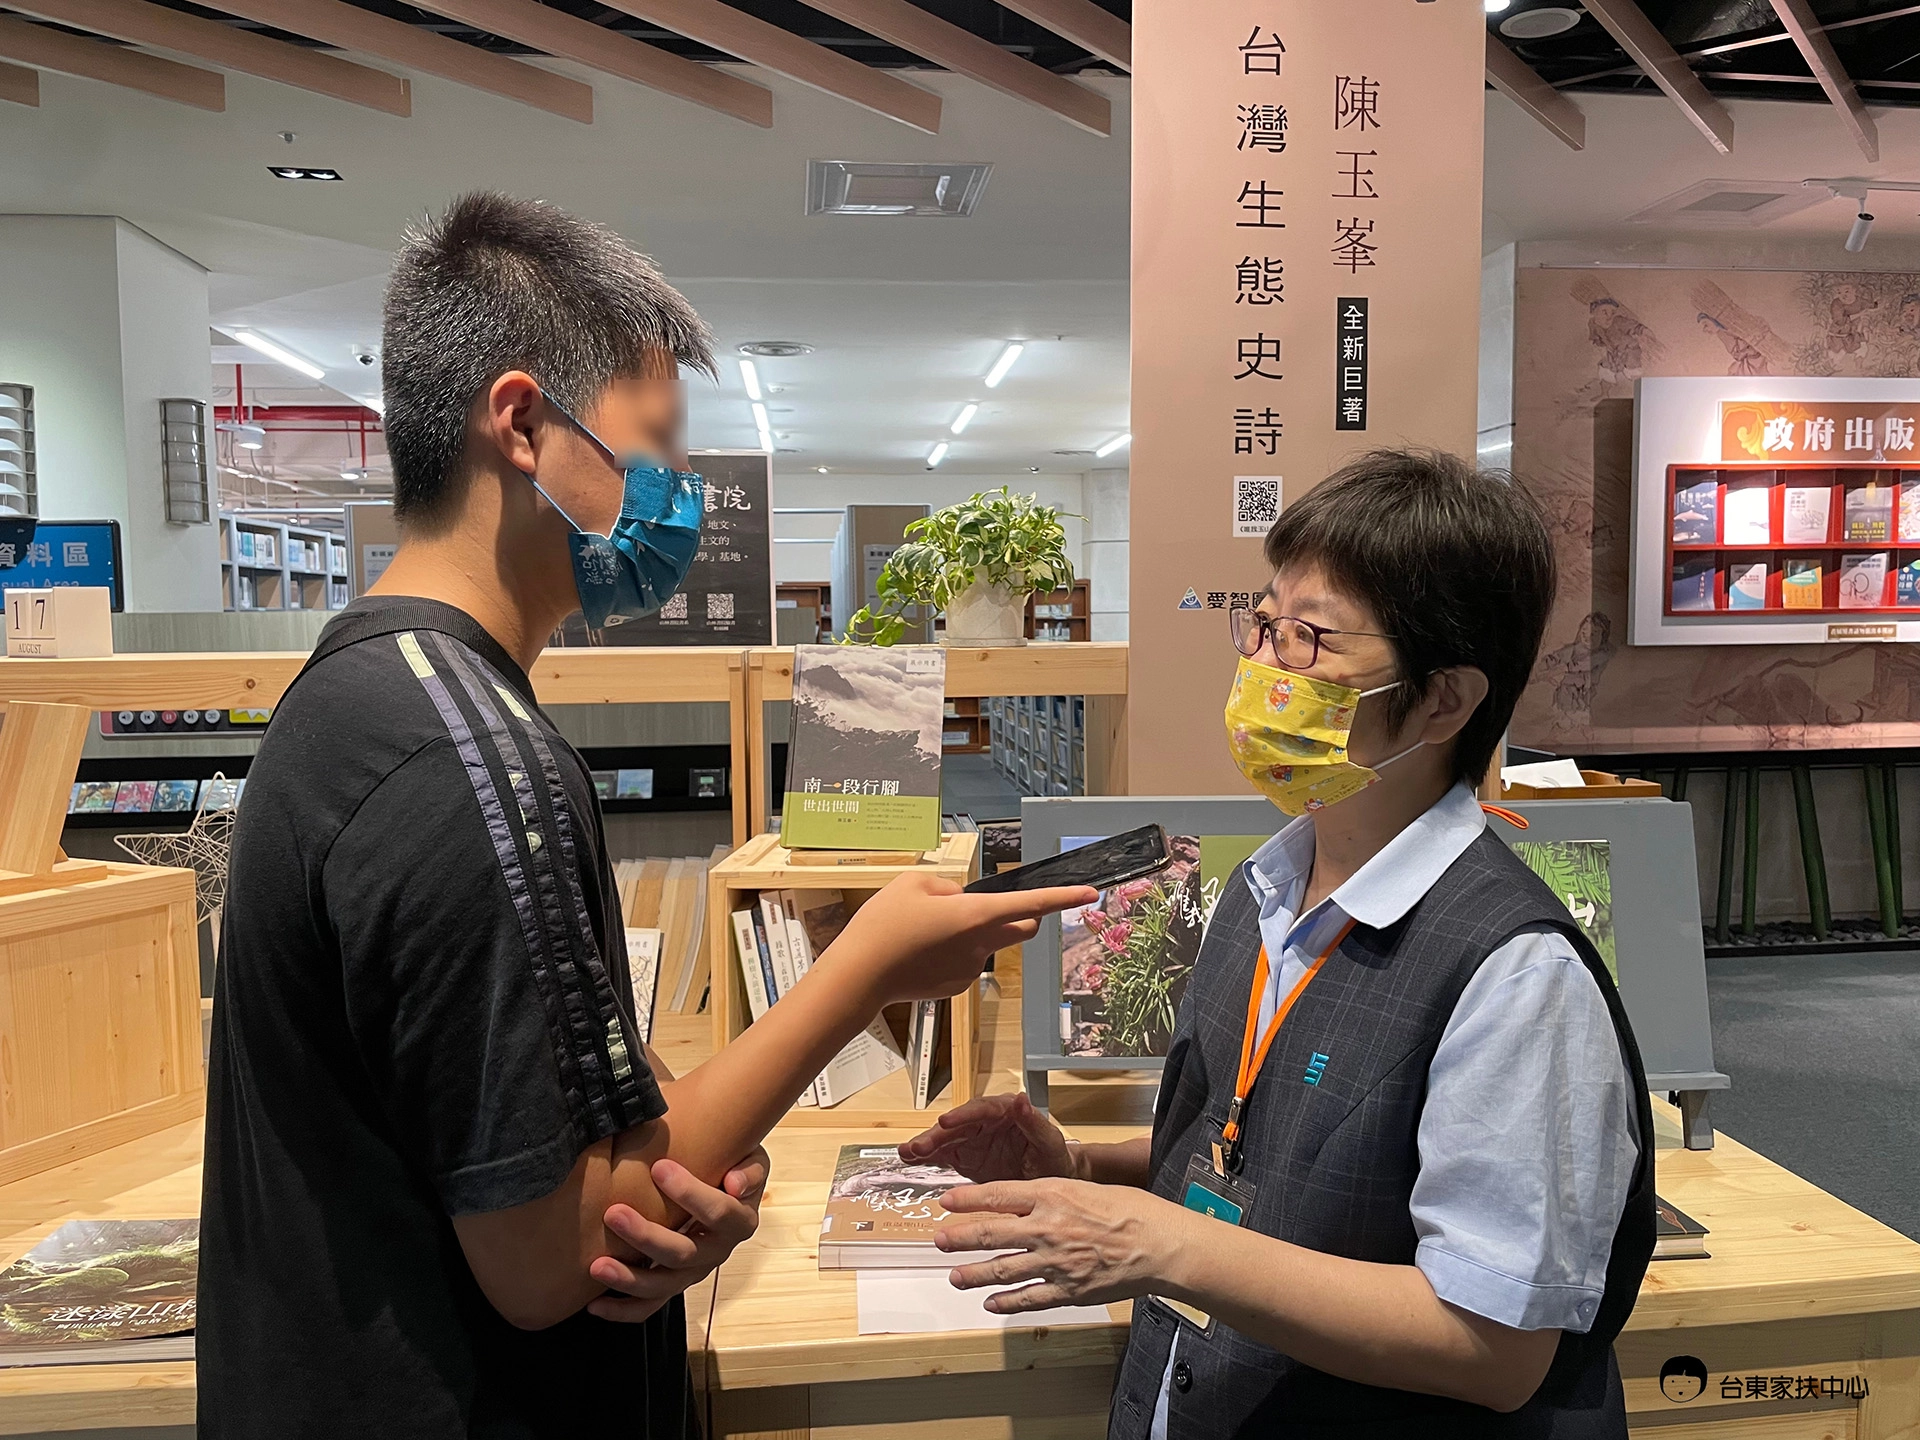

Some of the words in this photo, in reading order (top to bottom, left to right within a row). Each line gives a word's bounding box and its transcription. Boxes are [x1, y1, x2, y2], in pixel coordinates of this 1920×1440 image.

[1331, 74, 1381, 275] 陳玉峯
[1232, 25, 1289, 457] 台灣生態史詩
[1342, 303, 1365, 424] 全新巨著
[1762, 416, 1915, 451] 政府出版
[703, 482, 751, 513] 書院
[0, 542, 90, 568] 資料區
[18, 643, 42, 655] AUGUST
[803, 777, 901, 797] 南一段行腳
[803, 799, 860, 814] 世出世間
